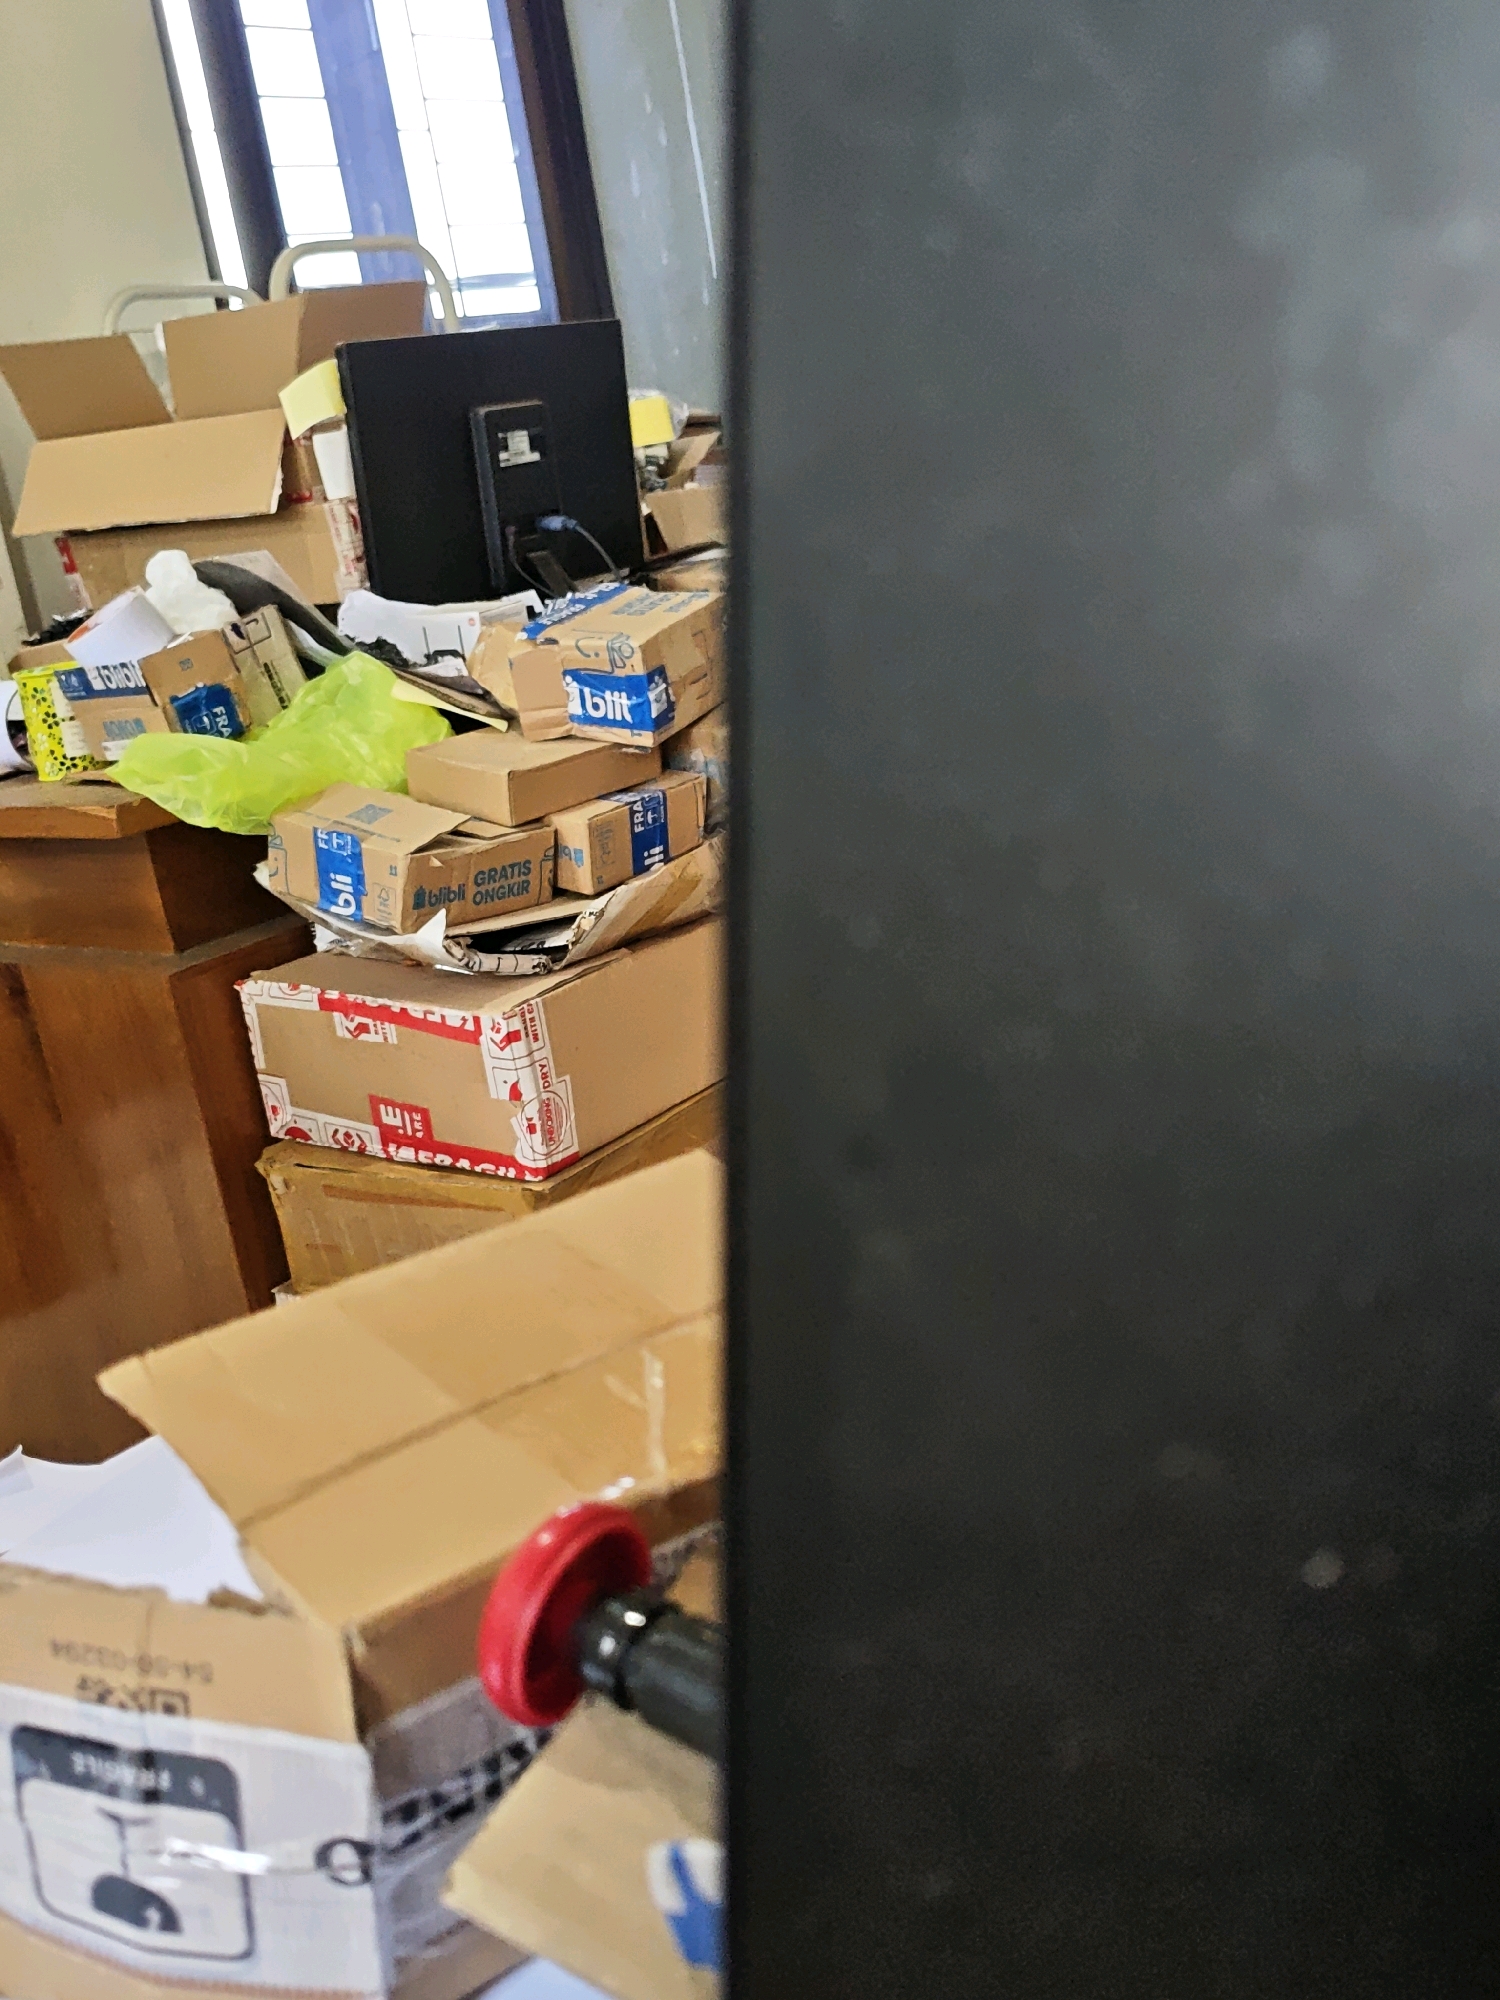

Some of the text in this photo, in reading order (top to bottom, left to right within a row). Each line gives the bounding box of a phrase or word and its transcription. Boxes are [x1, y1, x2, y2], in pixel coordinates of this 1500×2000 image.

[473, 859, 531, 887] GRATIS
[428, 884, 465, 907] blibli
[472, 879, 531, 906] ONGKIR
[539, 1063, 551, 1090] DRY
